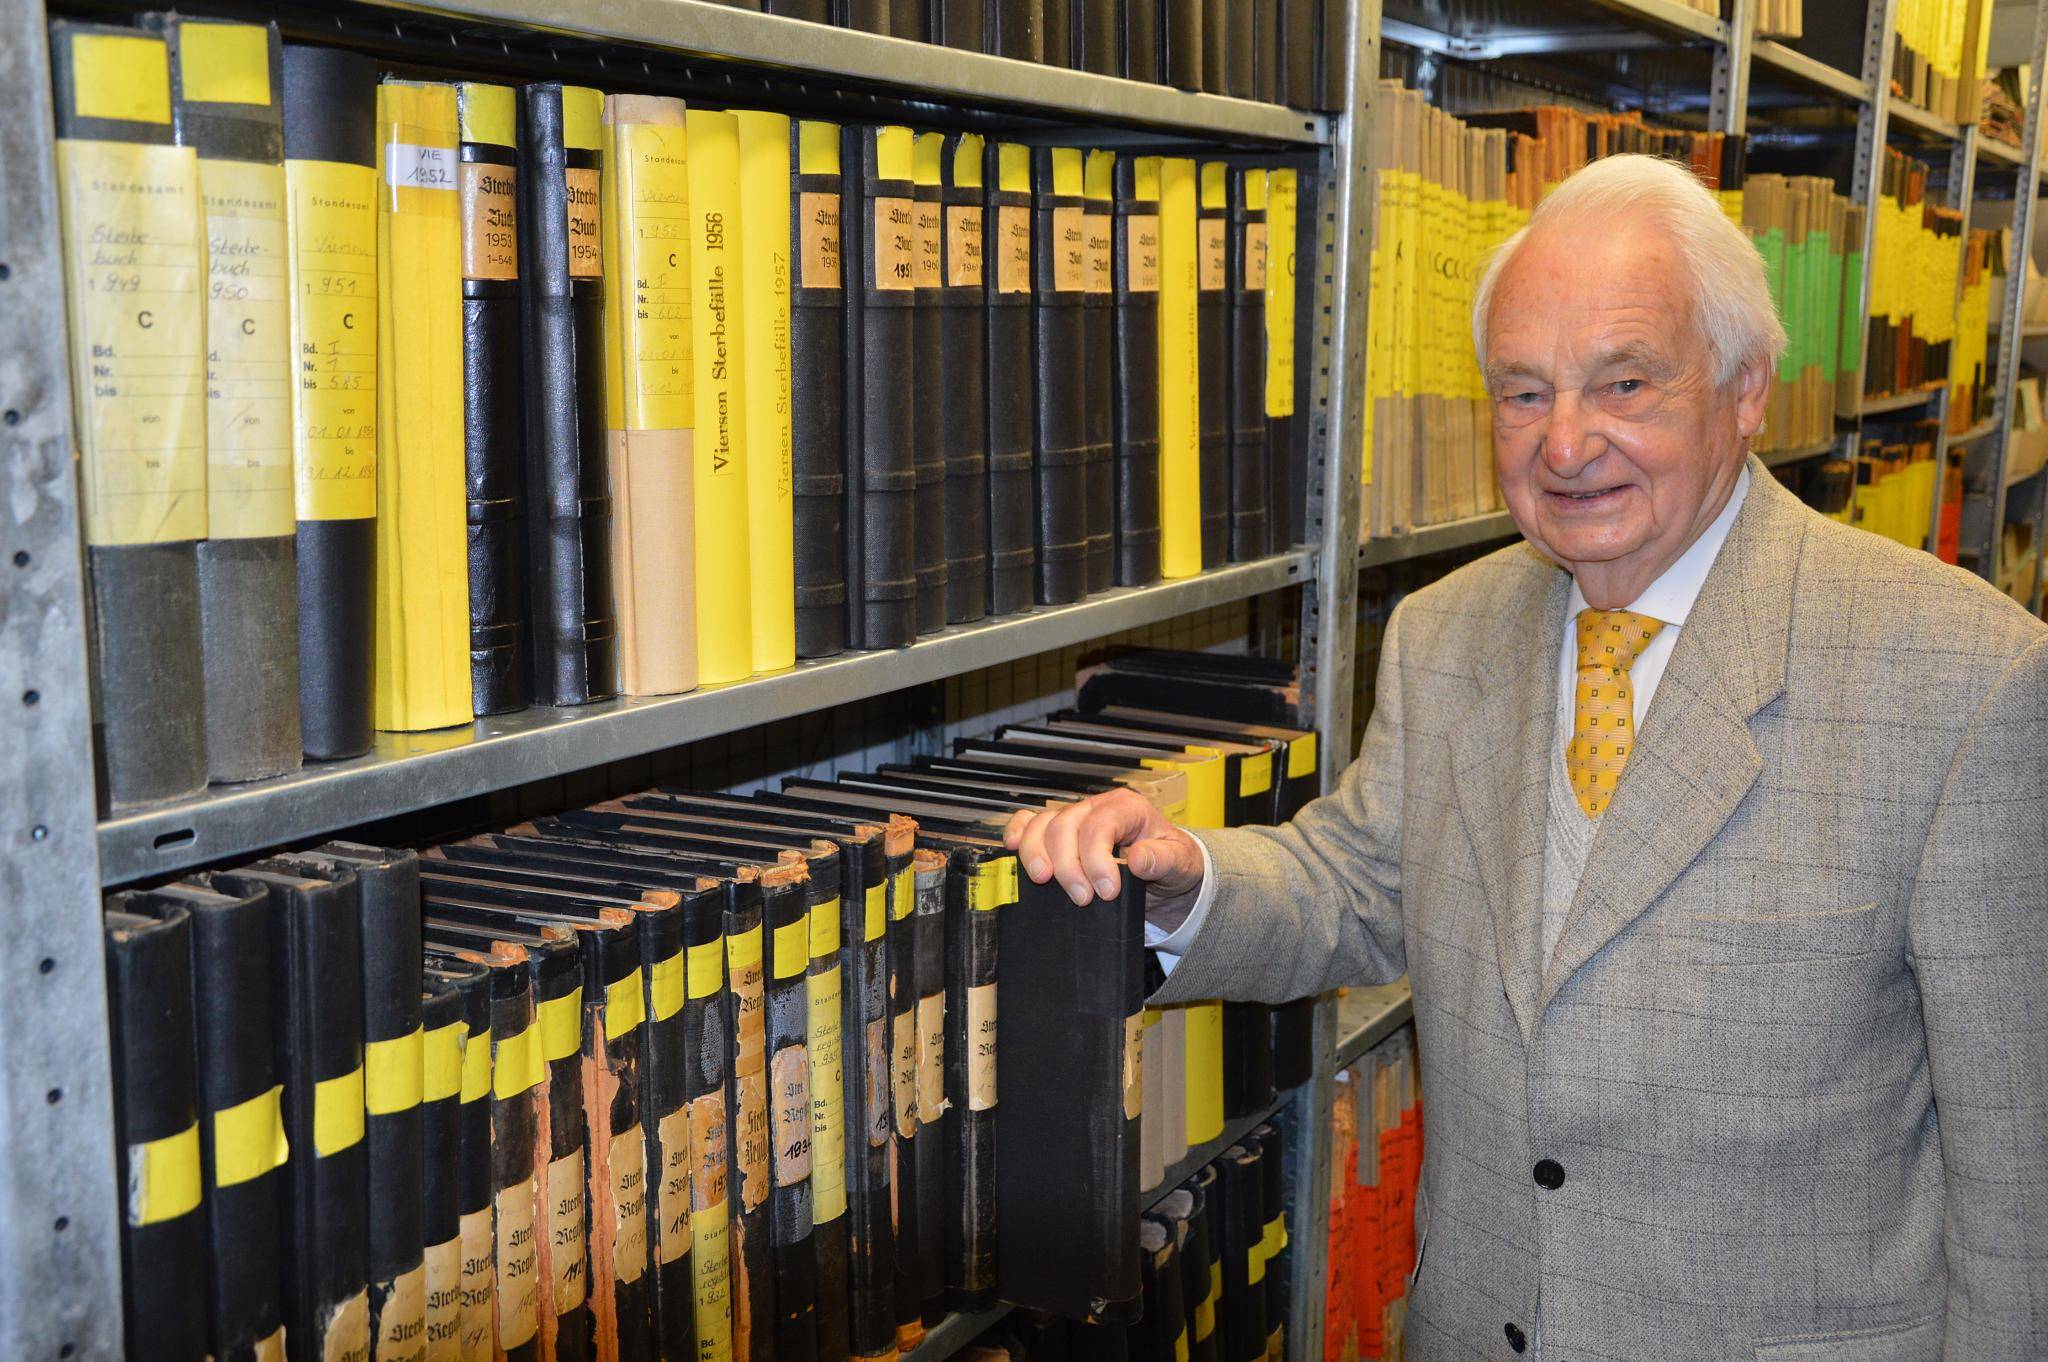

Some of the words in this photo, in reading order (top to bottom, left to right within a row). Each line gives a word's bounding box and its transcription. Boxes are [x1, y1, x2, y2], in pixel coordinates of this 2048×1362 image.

[417, 149, 442, 161] VIE
[407, 167, 453, 183] 1952
[570, 217, 597, 236] Buch
[706, 212, 723, 252] 1956
[485, 233, 513, 248] 1953
[572, 245, 598, 259] 1954
[669, 253, 677, 267] C
[773, 252, 786, 299] 1957
[637, 279, 650, 289] Bd.
[637, 295, 649, 304] Nr.
[138, 311, 153, 329] C
[343, 313, 354, 329] C
[637, 310, 649, 319] bis
[242, 319, 256, 335] C
[708, 265, 728, 380] Sterbefälle
[93, 345, 117, 357] Bd.
[303, 343, 318, 354] Bd.
[303, 361, 317, 372] Nr.
[773, 307, 787, 415] Sterbefälle
[94, 365, 113, 377] Nr.
[303, 379, 317, 389] bis
[95, 385, 117, 397] bis
[713, 391, 730, 474] Viersen
[777, 425, 788, 504] Viersen
[814, 1099, 828, 1108] Bd.
[814, 1124, 827, 1132] bis
[701, 1338, 716, 1348] Bd.
[701, 1351, 714, 1361] Nr.
